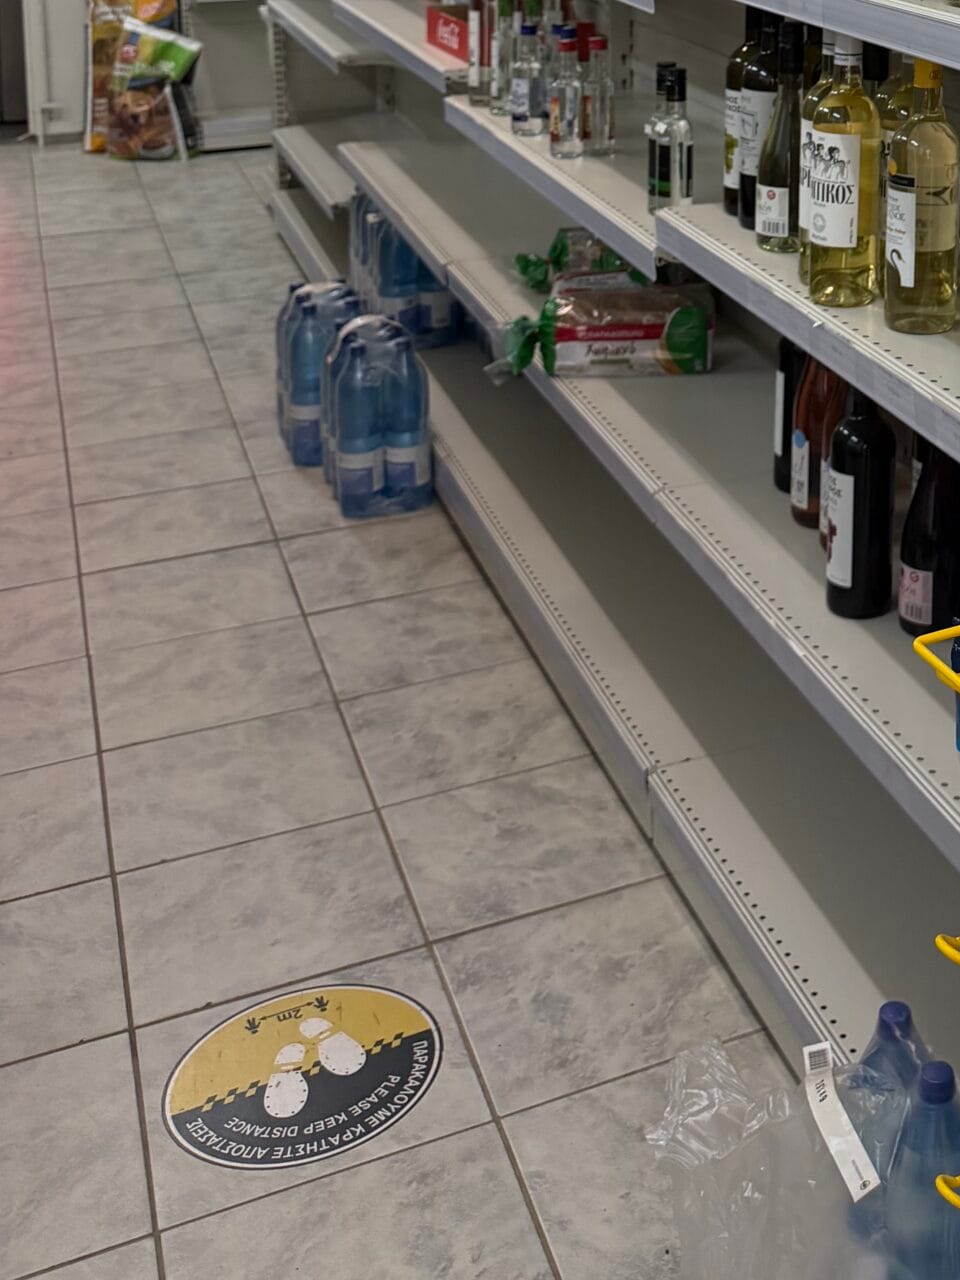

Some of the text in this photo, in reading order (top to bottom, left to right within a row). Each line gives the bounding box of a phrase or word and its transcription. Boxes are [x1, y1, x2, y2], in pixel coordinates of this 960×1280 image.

[277, 1009, 303, 1023] 2m
[185, 1040, 429, 1161] ΠΑΡΑΚΑΛΟΥΜΕ ΚΡΑΤΗΣΤΕ ΑΠΟΣΤΑΣΕΙΣ
[223, 1074, 401, 1138] PLEASE KEEP DISTANCE
